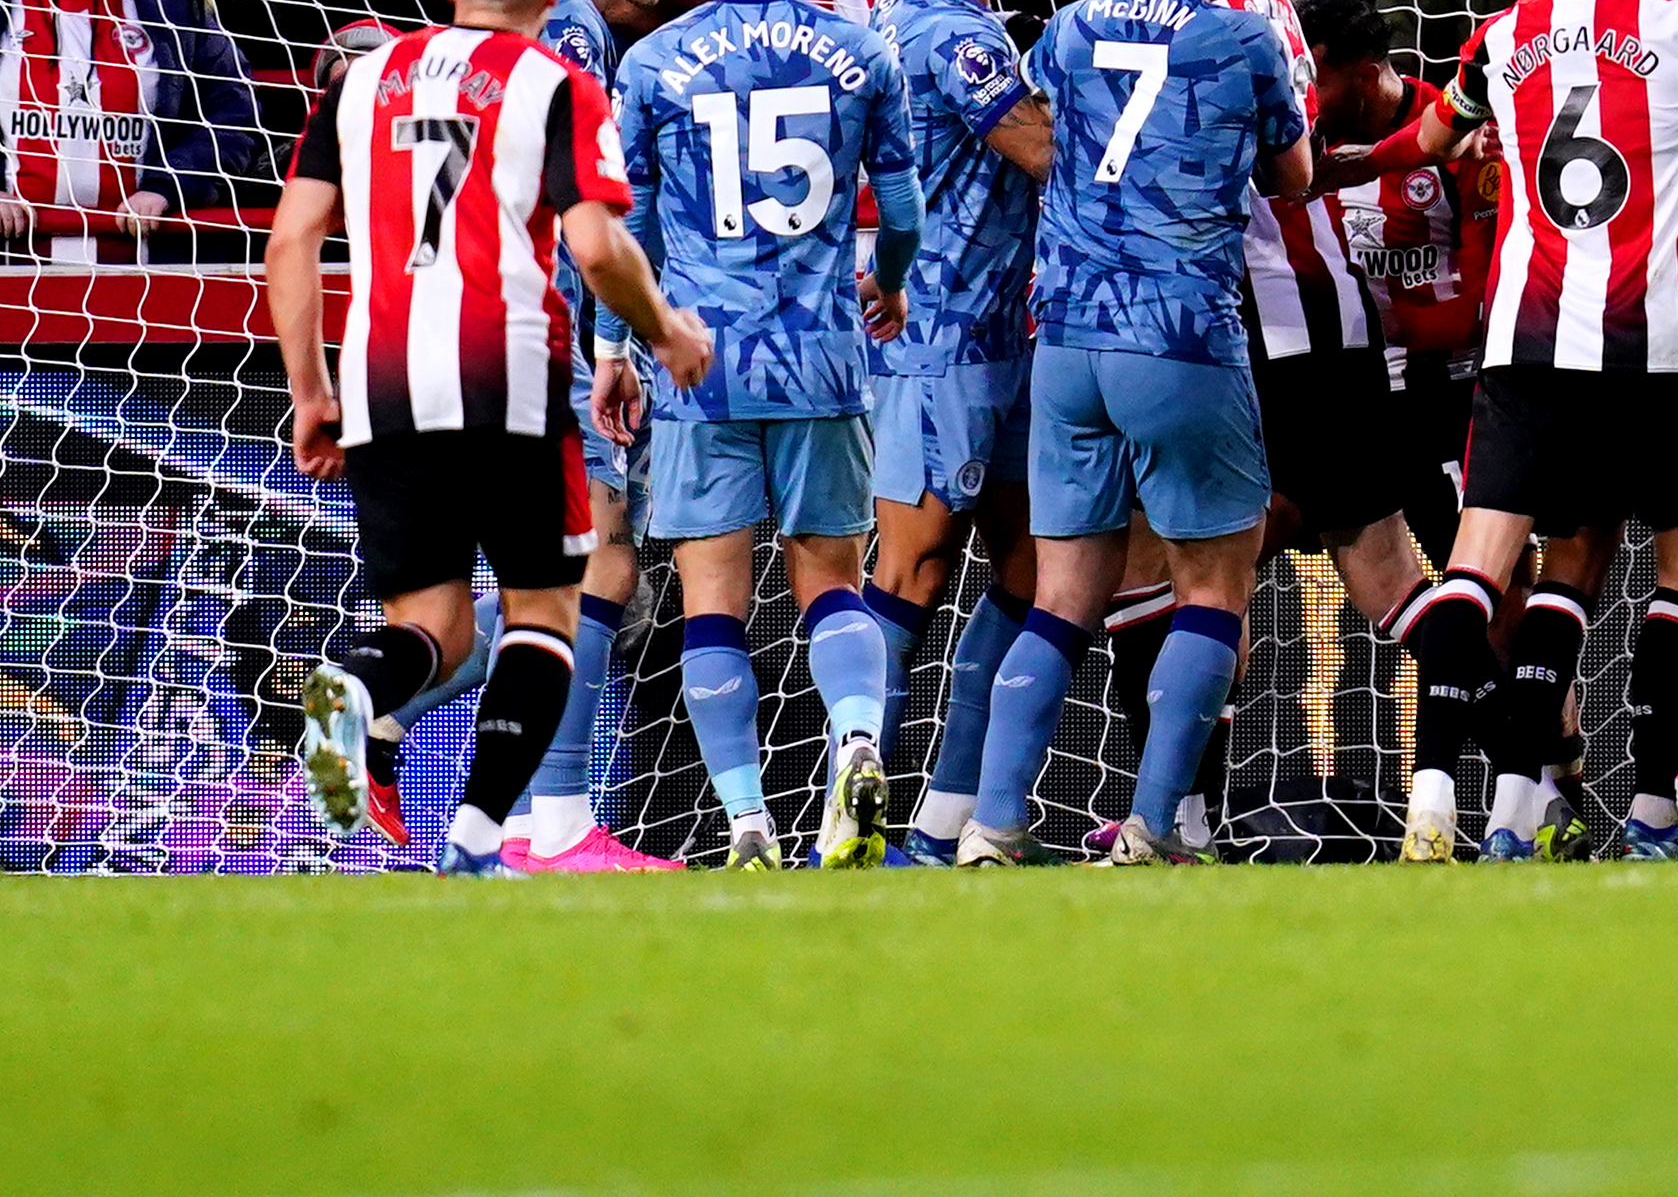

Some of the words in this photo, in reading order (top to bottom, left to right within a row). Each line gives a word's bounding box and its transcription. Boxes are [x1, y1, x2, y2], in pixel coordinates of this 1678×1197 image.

[660, 23, 737, 95] ALEX
[743, 21, 867, 91] MORENO
[1502, 26, 1660, 94] NØRGAARD
[11, 111, 143, 141] HOLLYWOOD
[1092, 40, 1169, 183] 7
[114, 143, 142, 155] bets
[692, 85, 835, 239] 15
[1538, 83, 1630, 229] 6
[392, 114, 480, 274] 7
[1403, 269, 1437, 287] bets
[1516, 665, 1557, 684] BEES
[1429, 685, 1470, 702] BEES
[1473, 680, 1497, 703] ES
[1634, 705, 1653, 717] ES
